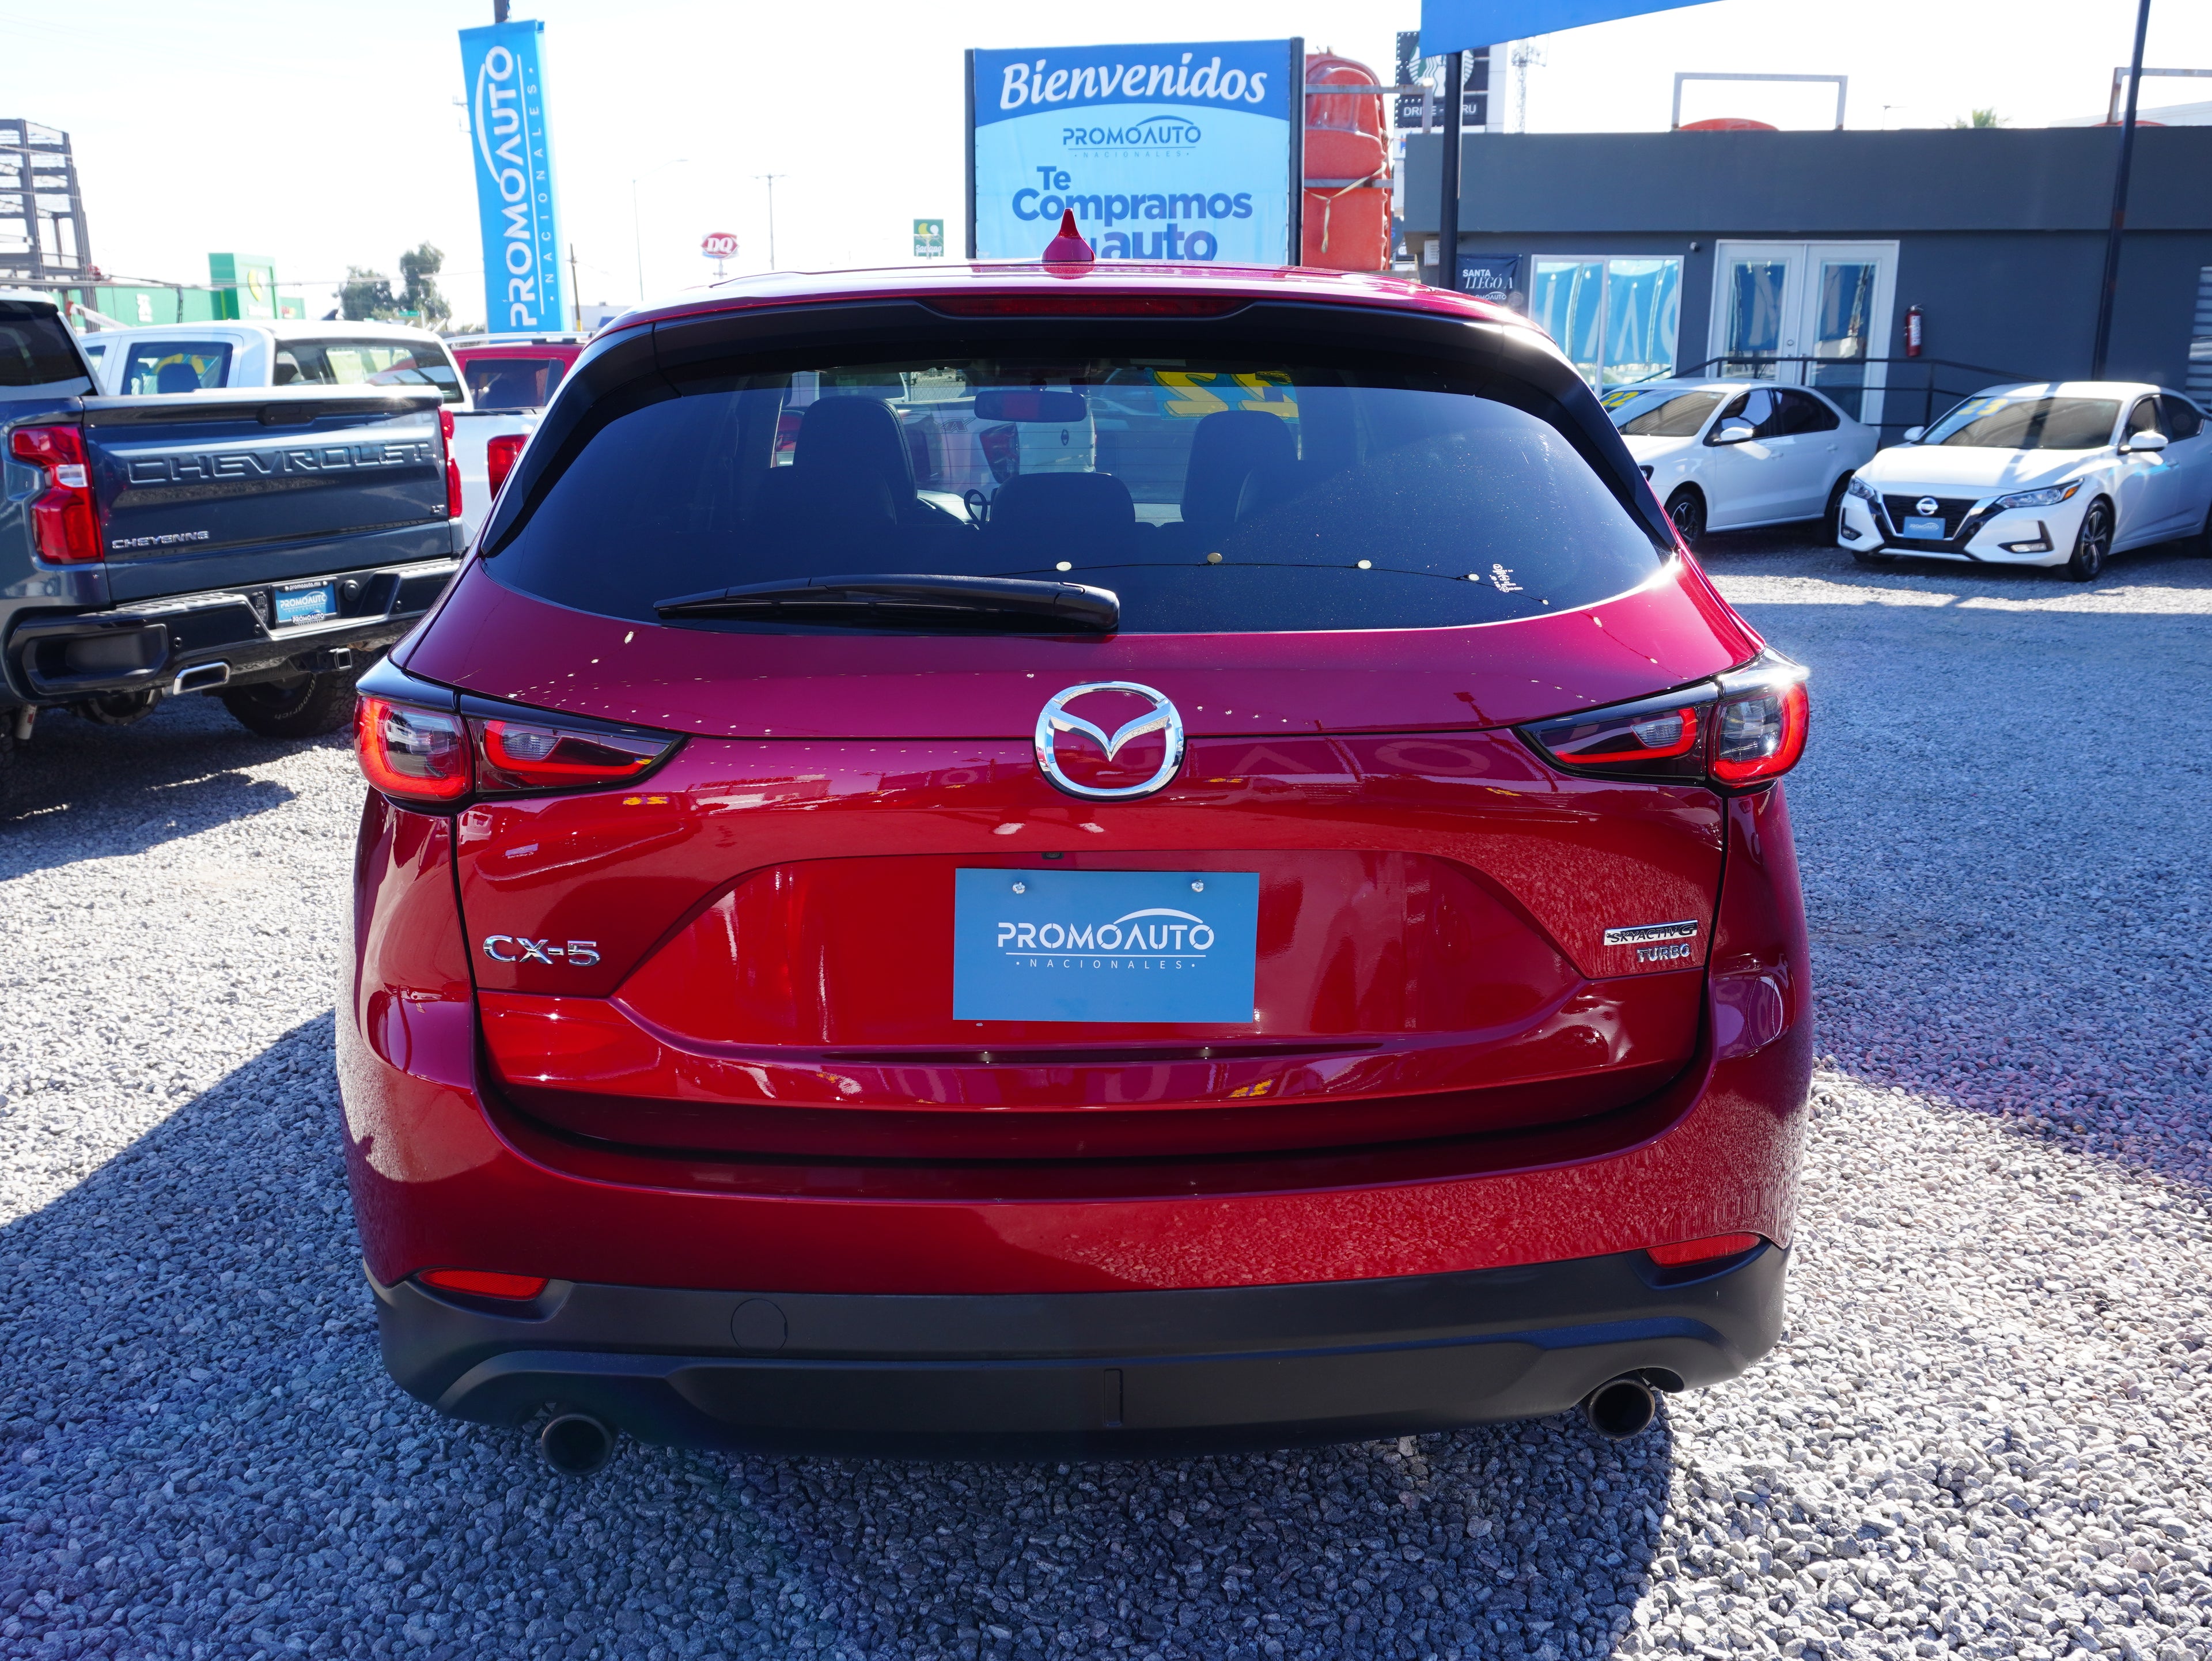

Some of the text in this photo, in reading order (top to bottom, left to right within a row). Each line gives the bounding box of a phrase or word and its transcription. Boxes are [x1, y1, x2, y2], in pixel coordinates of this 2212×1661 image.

[1000, 52, 1267, 109] Bienvenidos
[1403, 106, 1437, 116] DRIE
[1063, 125, 1201, 146] PROMOAUTO
[1084, 150, 1181, 158] NACIONALES
[485, 46, 537, 327] PROMOAUTO
[527, 85, 554, 283] NACIONALES
[1037, 165, 1071, 190] Te
[1012, 187, 1253, 226] Compramos
[706, 237, 734, 253] DQ
[915, 244, 942, 252] Sorana
[1101, 223, 1218, 261] auto
[1463, 269, 1491, 277] SANTA
[1465, 274, 1513, 289] LLEGÓ A
[1601, 391, 1639, 407] 22
[1957, 398, 2008, 415] 23
[127, 442, 430, 483] CHEVROLET
[112, 530, 210, 550] CHEYENNE
[289, 581, 321, 591] promoauto.mx
[280, 593, 327, 608] PROMOAUTO
[292, 612, 325, 623] PROMOAUTO
[998, 922, 1215, 950] PROMOAUTO
[483, 934, 601, 967] CX-5
[1637, 943, 1690, 963] TURBO
[1030, 959, 1183, 970] NACIONALES
